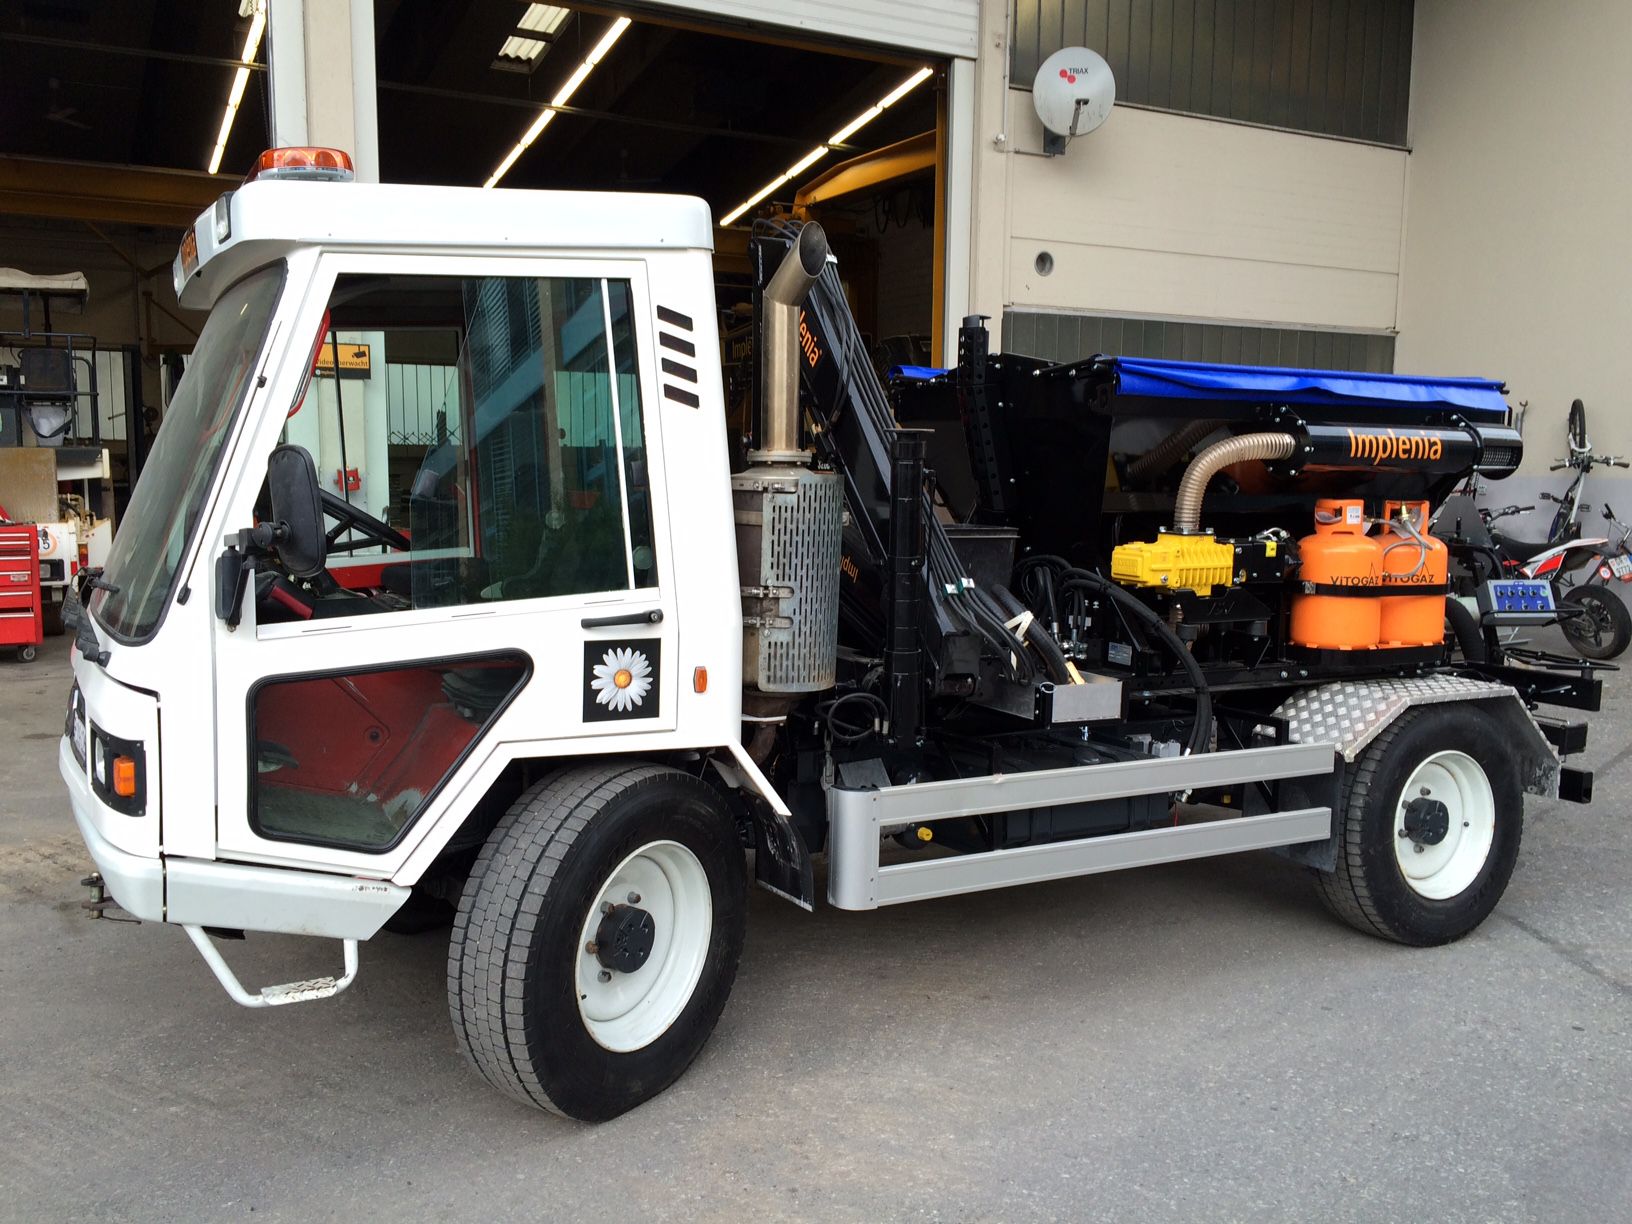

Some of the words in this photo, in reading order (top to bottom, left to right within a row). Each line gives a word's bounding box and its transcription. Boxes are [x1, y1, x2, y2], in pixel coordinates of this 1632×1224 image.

[799, 310, 820, 368] lenia
[316, 357, 369, 368] Videoerwacht
[1347, 428, 1442, 465] Implenia
[840, 555, 859, 584] Impl
